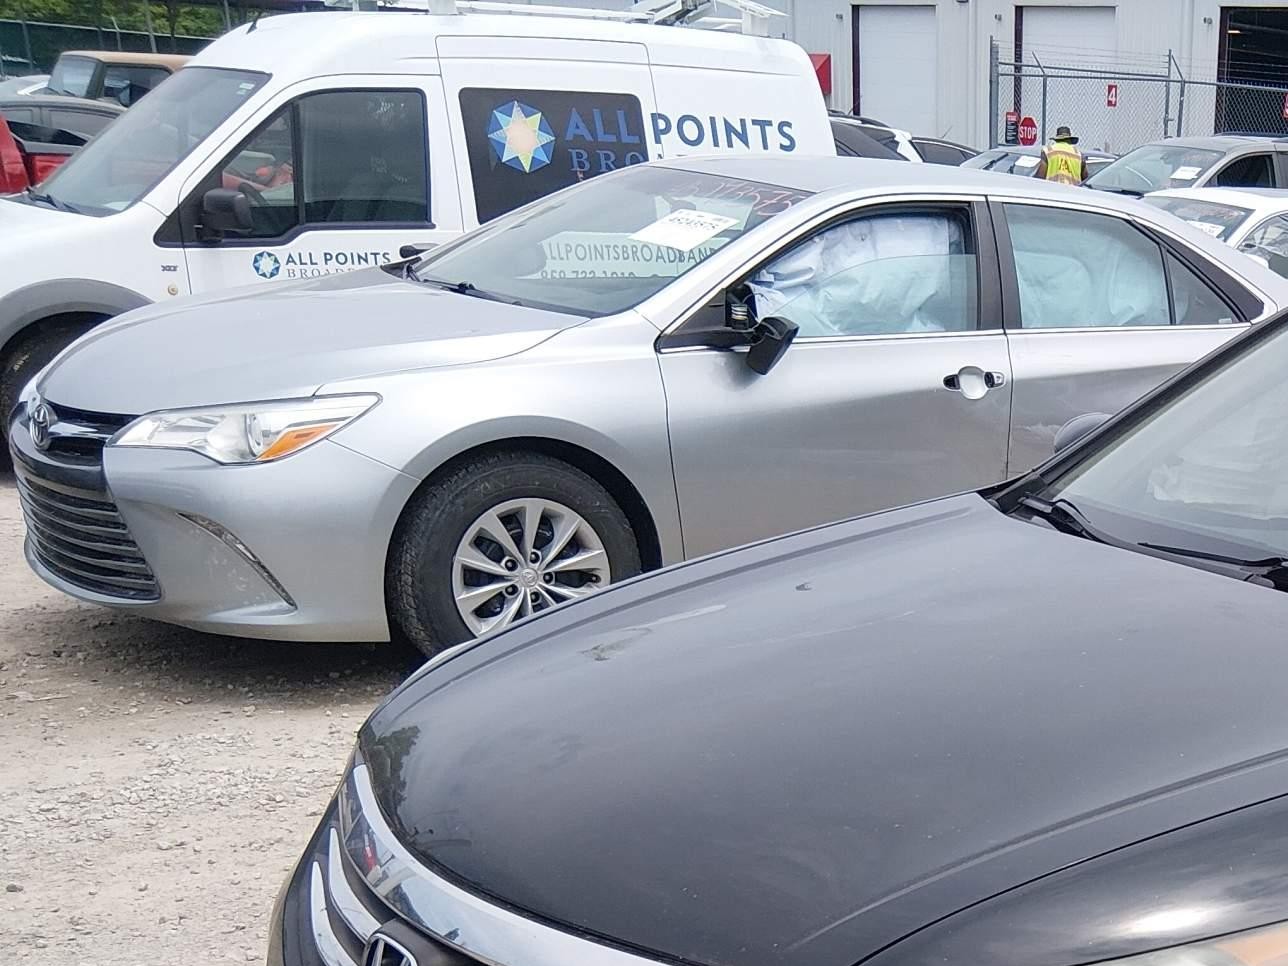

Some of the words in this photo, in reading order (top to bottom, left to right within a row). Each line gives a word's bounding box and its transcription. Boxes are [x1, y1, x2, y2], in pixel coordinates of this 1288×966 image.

[1108, 87, 1117, 105] 4
[564, 108, 641, 144] ALL
[650, 112, 798, 152] POINTS
[1020, 126, 1037, 139] STOP
[286, 252, 318, 265] ALL
[324, 252, 391, 266] POINTS
